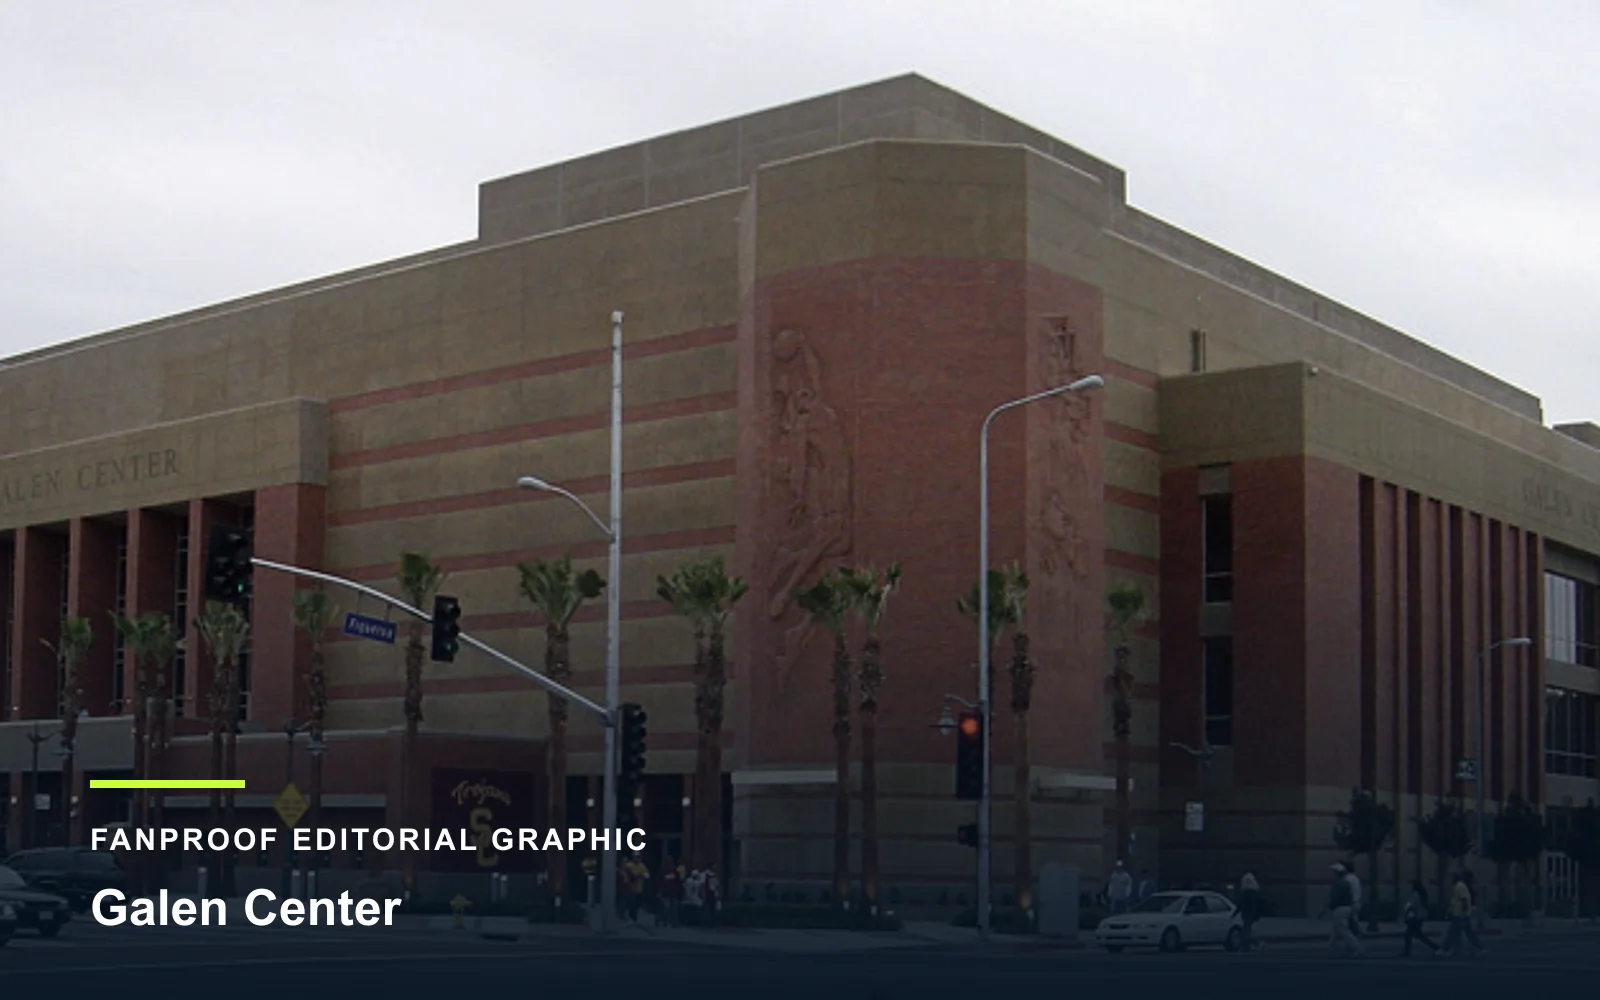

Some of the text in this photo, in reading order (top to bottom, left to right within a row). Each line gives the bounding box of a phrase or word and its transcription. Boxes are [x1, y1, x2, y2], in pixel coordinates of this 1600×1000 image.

[76, 448, 178, 491] CENTER
[348, 616, 393, 639] Figueroa
[450, 777, 512, 806] Trojans
